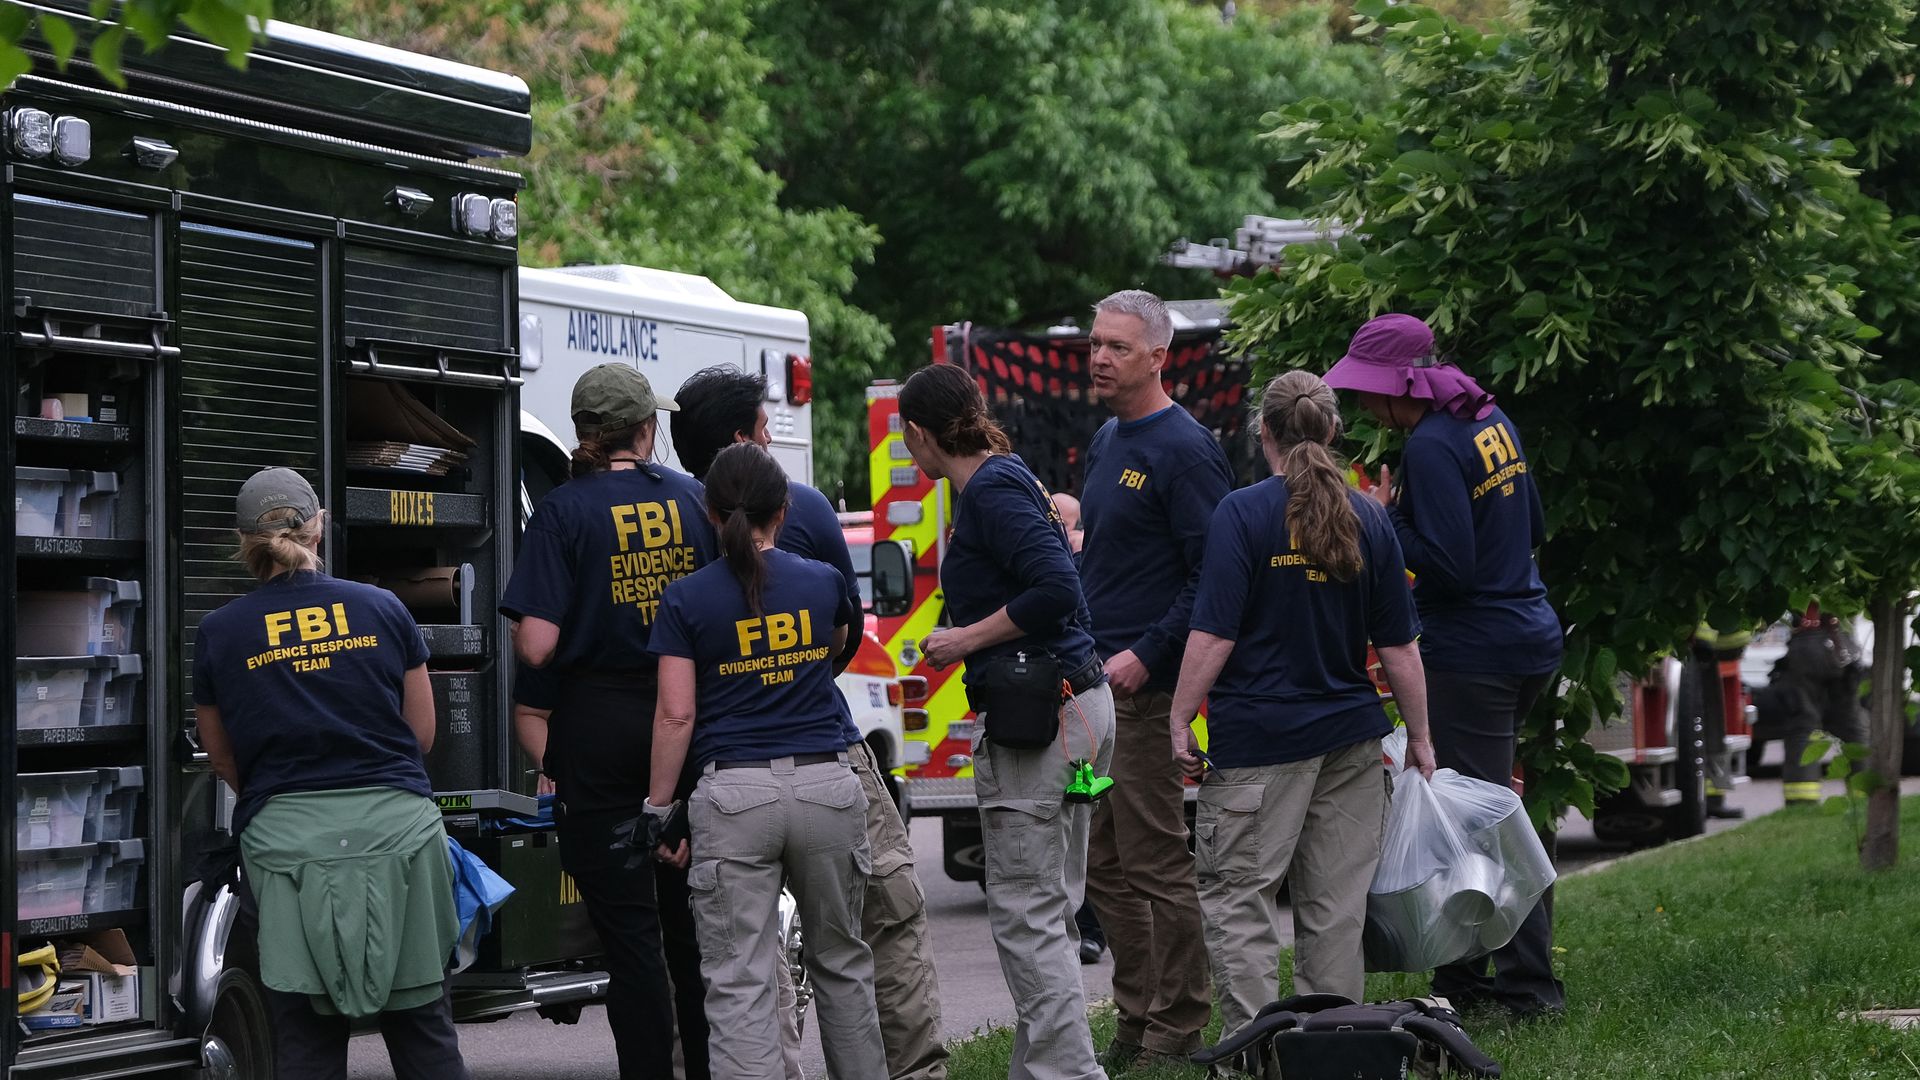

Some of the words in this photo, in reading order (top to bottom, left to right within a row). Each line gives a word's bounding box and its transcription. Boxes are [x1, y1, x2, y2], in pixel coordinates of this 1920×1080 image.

[567, 310, 659, 361] AMBULANCE
[53, 422, 65, 437] ZIP
[66, 423, 81, 438] TIES
[113, 427, 130, 441] TAPE
[1473, 422, 1519, 474] FBI
[1118, 468, 1147, 490] FBI
[391, 490, 434, 526] BOXES
[610, 499, 684, 552] FBI
[34, 538, 63, 553] PLASTIC
[64, 540, 83, 554] BAGS
[610, 546, 695, 579] EVIDENCE
[1271, 553, 1315, 568] EVIDEN
[611, 572, 690, 605] RESPO
[636, 600, 660, 626] TE
[264, 602, 350, 646] FBI
[735, 609, 812, 657] FBI
[463, 628, 482, 641] BROWN
[246, 645, 309, 670] EVIDENCE
[311, 635, 378, 655] RESPONSE
[463, 642, 482, 654] PAPER
[292, 656, 331, 673] TEAM
[719, 657, 775, 676] EVIDENCE
[449, 678, 467, 690] TRACE
[760, 669, 794, 686] TEAM
[448, 691, 470, 703] VACUUM
[450, 708, 467, 721] TRACE
[43, 729, 66, 743] PAPER
[67, 728, 85, 742] BAGS
[450, 721, 471, 734] FILTERS
[30, 916, 69, 935] SPECIALITY
[70, 914, 89, 930] BAGS
